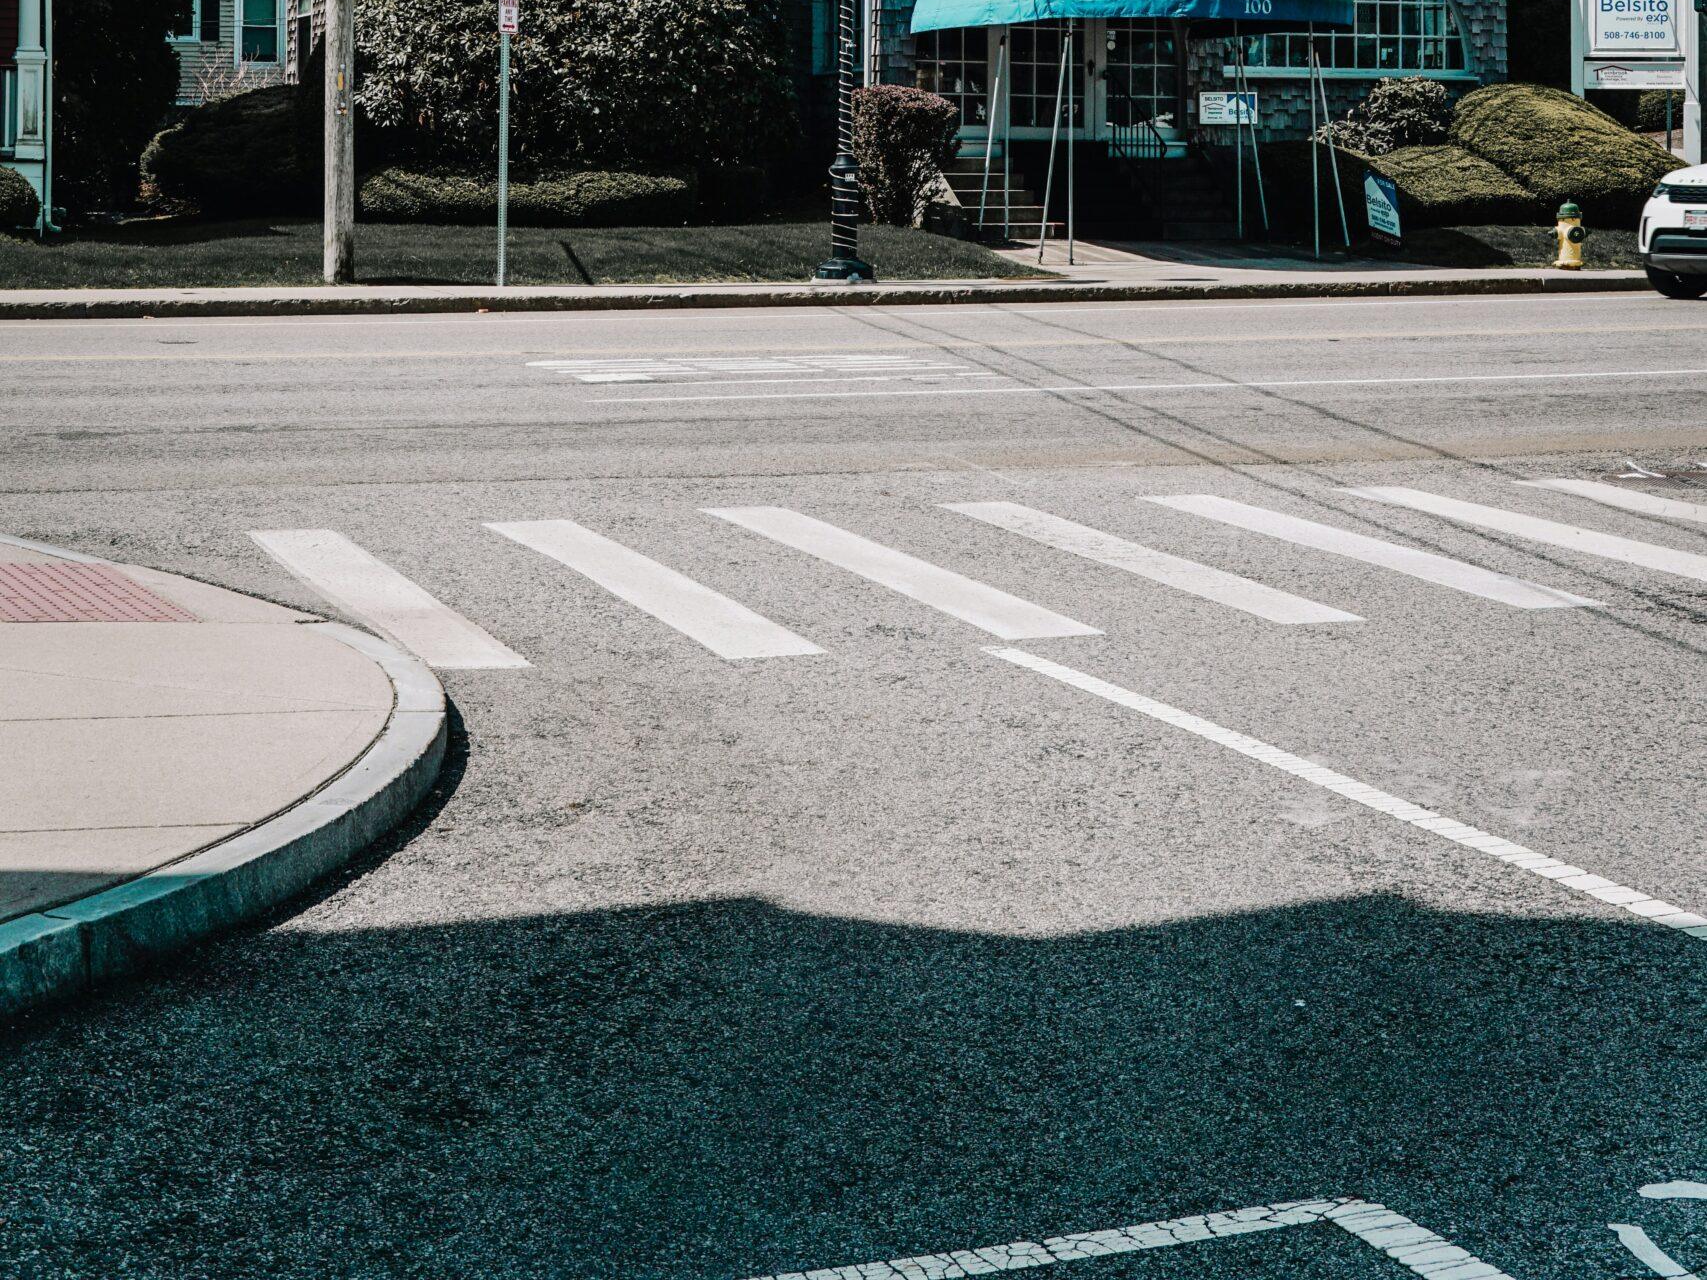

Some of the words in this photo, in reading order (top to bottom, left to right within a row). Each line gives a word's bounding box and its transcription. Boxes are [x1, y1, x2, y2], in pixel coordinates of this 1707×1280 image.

[1244, 0, 1272, 14] 100
[1646, 13, 1668, 25] exp
[1604, 31, 1666, 39] 508-746-8100
[1367, 195, 1392, 211] Belsito
